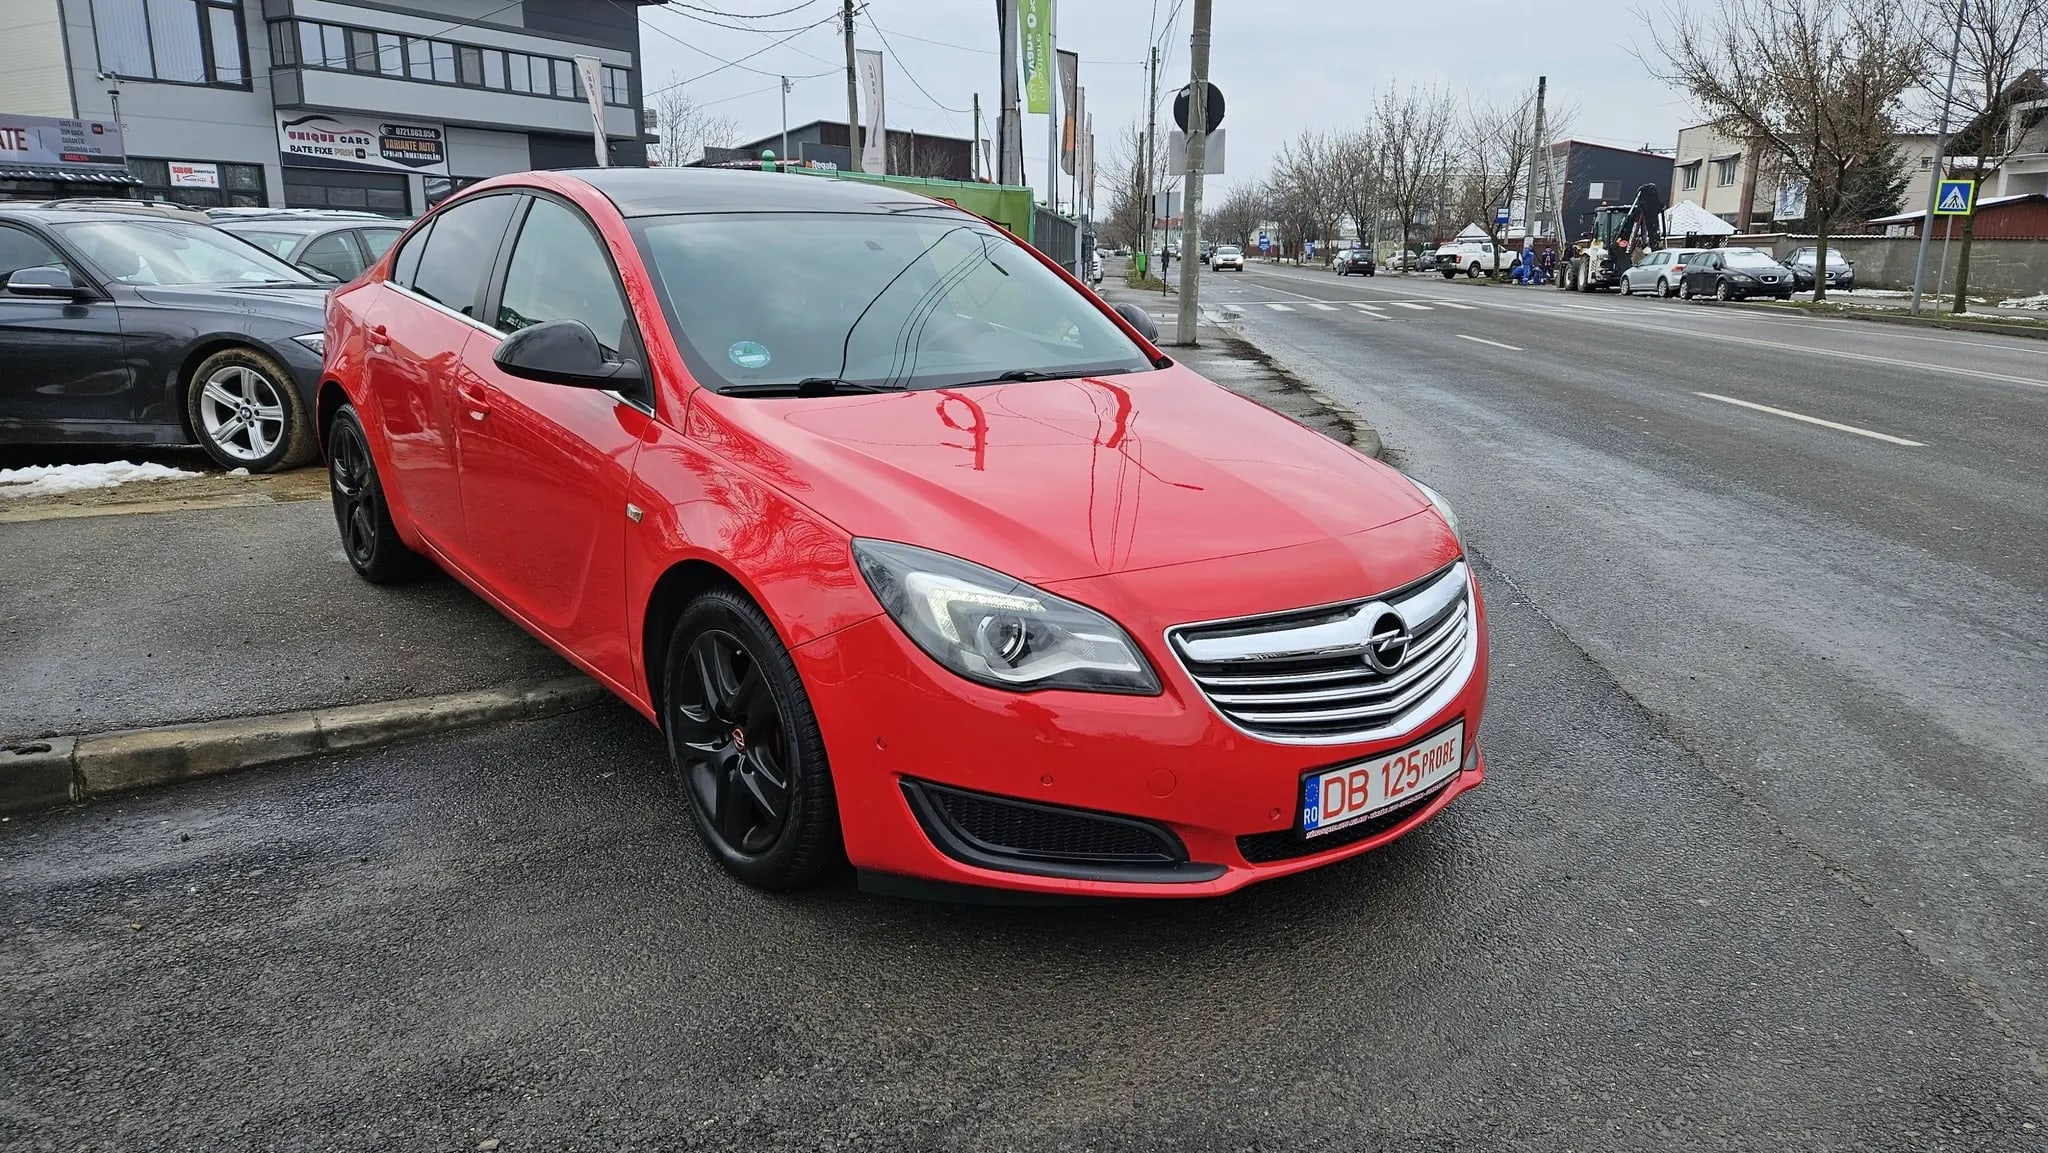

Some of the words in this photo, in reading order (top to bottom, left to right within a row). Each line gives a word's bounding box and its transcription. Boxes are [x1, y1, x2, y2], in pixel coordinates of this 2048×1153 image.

[288, 131, 335, 143] UNIQUE
[340, 136, 370, 145] CARS
[289, 145, 313, 154] RATE
[314, 147, 333, 155] FIXE
[384, 139, 418, 151] VARIANTE
[418, 141, 436, 152] AUTO
[1323, 769, 1370, 820] DB
[1382, 749, 1421, 798] 125
[1421, 737, 1456, 779] PROBE
[1304, 806, 1318, 826] RO
